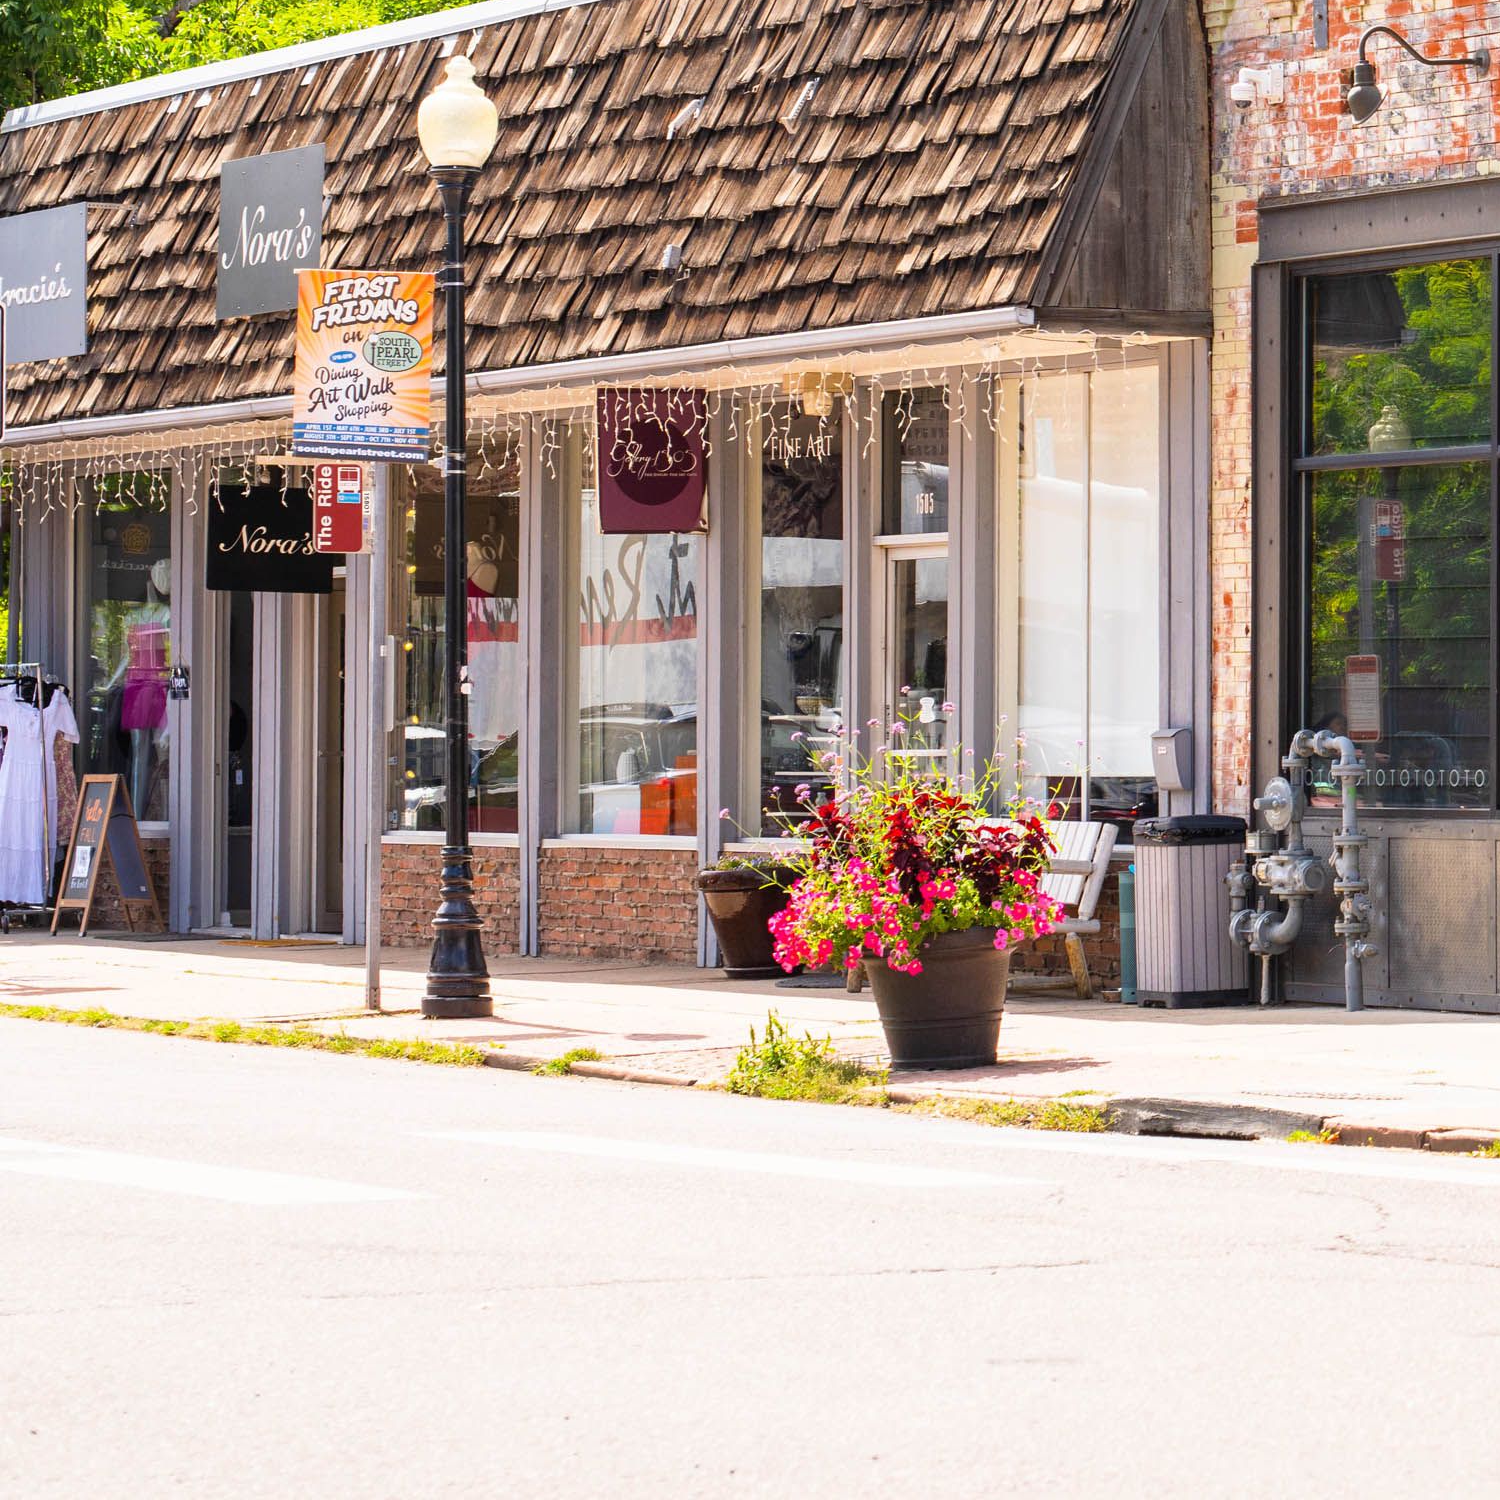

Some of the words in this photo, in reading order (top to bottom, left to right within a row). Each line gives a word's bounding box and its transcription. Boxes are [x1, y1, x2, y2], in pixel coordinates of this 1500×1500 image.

[222, 205, 316, 269] Nora's
[0, 262, 72, 307] racie's
[323, 276, 400, 304] FIRST
[312, 298, 419, 332] FRIDAYS
[343, 330, 364, 344] on
[379, 337, 411, 347] SOUTH
[376, 358, 407, 367] STREET
[377, 347, 418, 363] PEARL
[315, 366, 364, 384] Dining
[308, 387, 342, 412] Art
[346, 376, 397, 403] Walk
[335, 401, 393, 422] Shopping
[297, 445, 425, 460] southpearlstreet.com
[770, 436, 802, 460] FINE
[805, 435, 834, 458] ART
[317, 466, 333, 507] Ride
[916, 493, 934, 514] 1505
[219, 524, 315, 555] Nora's
[318, 515, 333, 549] The
